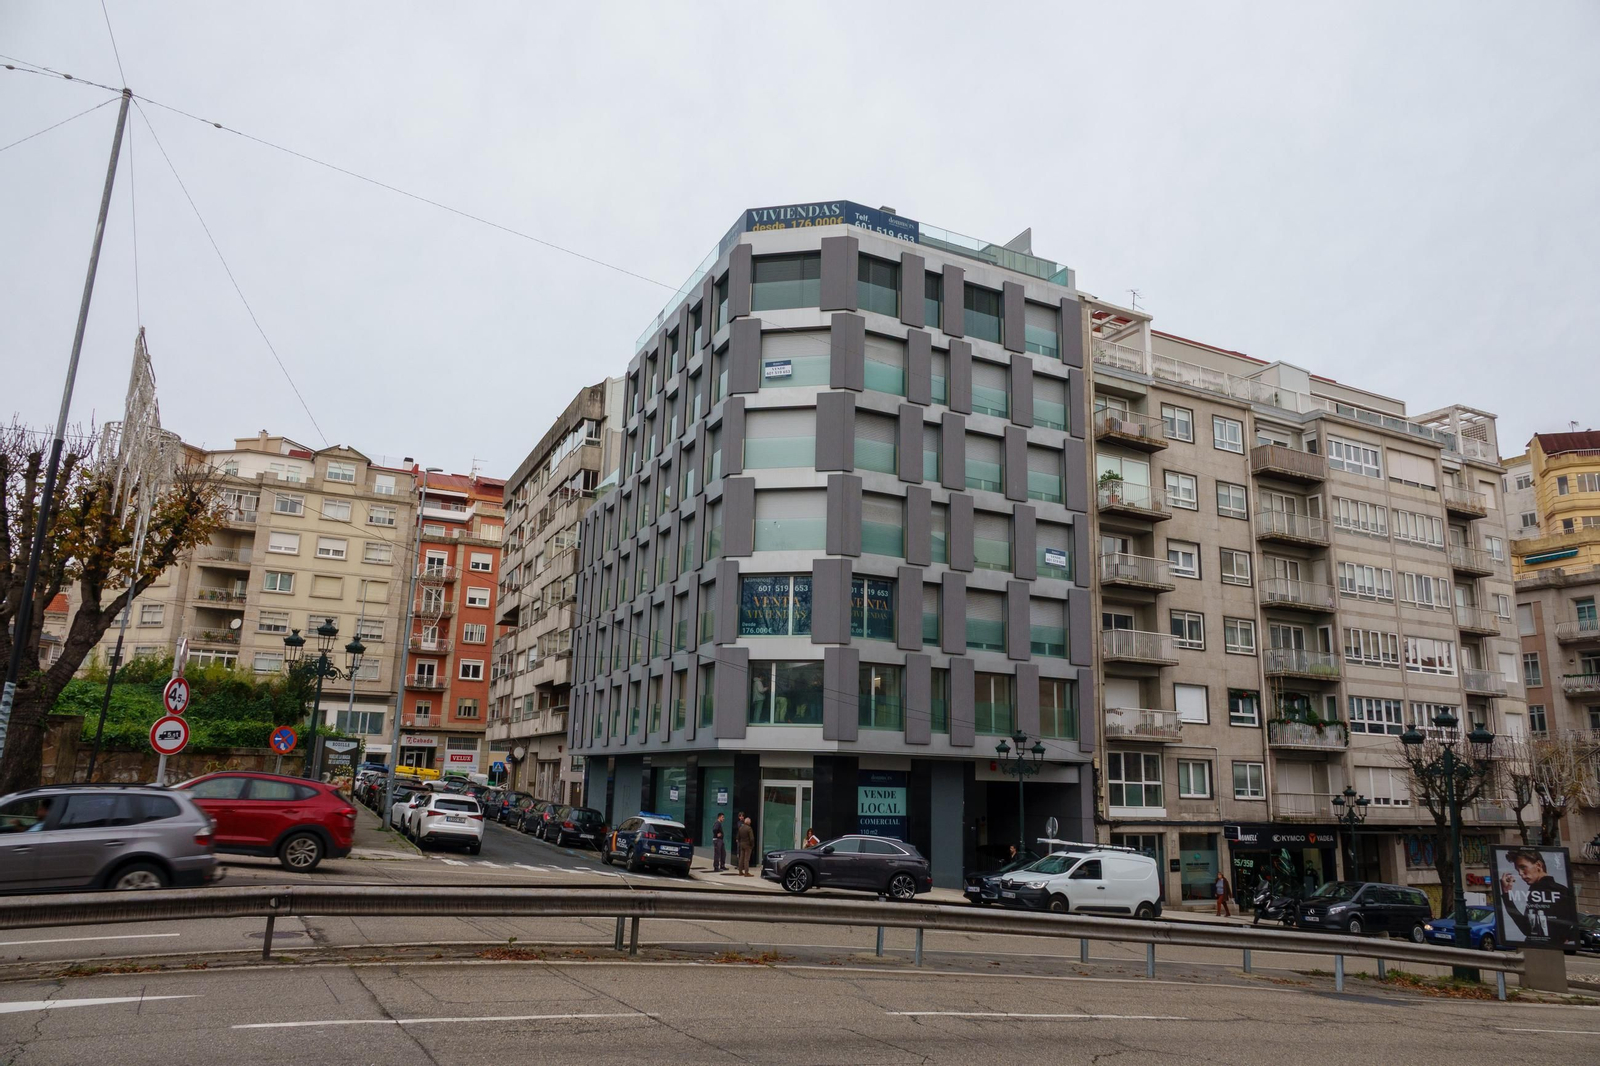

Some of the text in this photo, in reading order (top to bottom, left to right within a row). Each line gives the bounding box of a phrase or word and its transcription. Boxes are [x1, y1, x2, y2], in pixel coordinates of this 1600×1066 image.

[752, 203, 840, 222] VIVIENDAS
[855, 212, 870, 223] Telf.
[752, 221, 786, 232] desde
[855, 220, 915, 243] 601 519 653
[753, 596, 801, 608] VENTA
[863, 789, 897, 799] VENDE
[860, 802, 900, 814] LOCAL
[1508, 889, 1561, 904] MYSLF
